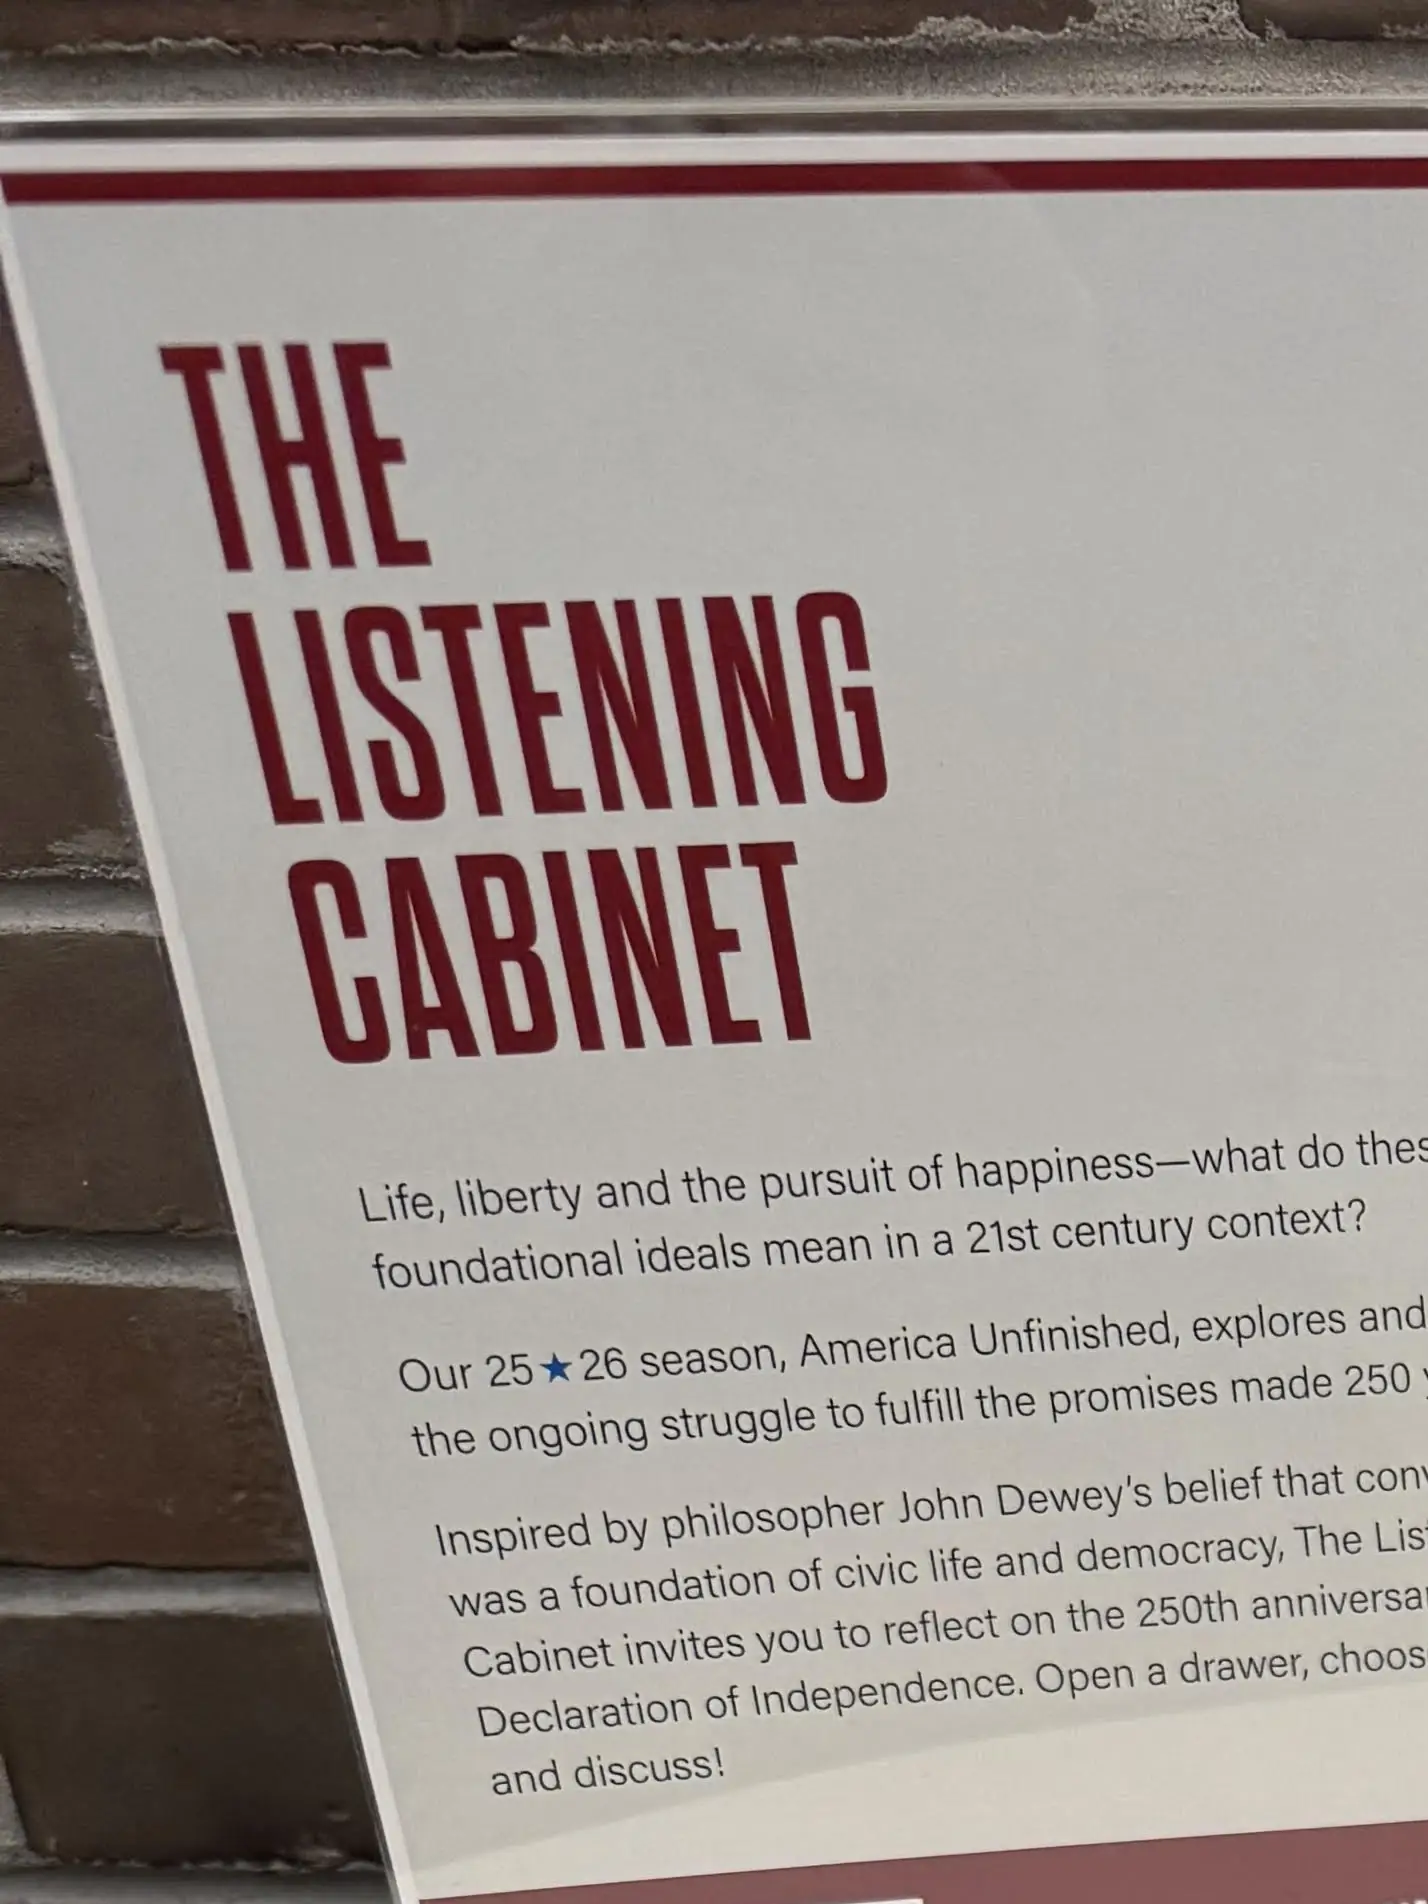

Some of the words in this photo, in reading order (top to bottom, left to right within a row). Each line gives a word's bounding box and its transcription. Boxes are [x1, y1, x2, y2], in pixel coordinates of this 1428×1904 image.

[159, 340, 431, 572] THE
[228, 591, 888, 825] LISTENING
[288, 841, 811, 1064] CABINET
[358, 1182, 445, 1224] Life,
[455, 1177, 581, 1221] liberty
[596, 1168, 671, 1209] and
[680, 1166, 746, 1204] the
[759, 1156, 897, 1209] pursuit
[907, 1152, 944, 1192] of
[1298, 1132, 1345, 1170] do
[371, 1238, 624, 1291] foundational
[634, 1232, 751, 1275] ideals
[763, 1234, 873, 1267] mean
[883, 1223, 920, 1259] in
[933, 1229, 954, 1257] a
[966, 1217, 1041, 1254] 21st
[1052, 1212, 1194, 1252] century
[1207, 1197, 1366, 1241] context?
[398, 1358, 473, 1393] Our
[639, 1344, 786, 1378] season,
[800, 1325, 957, 1368] America
[969, 1309, 1180, 1356] Unfinished,
[1192, 1303, 1347, 1349] explores
[1359, 1293, 1427, 1333] and
[410, 1421, 476, 1458] the
[488, 1410, 649, 1458] ongoing
[660, 1397, 816, 1444] struggle
[825, 1397, 865, 1429] to
[874, 1386, 964, 1426] fulfill
[974, 1384, 1036, 1420] the
[1048, 1374, 1218, 1424] promises
[1230, 1364, 1333, 1404] made
[1344, 1361, 1411, 1397] 250
[434, 1512, 592, 1561] Inspired
[601, 1510, 648, 1552] by
[661, 1494, 885, 1549] philosopher
[899, 1486, 984, 1524] John
[996, 1474, 1153, 1518] Dewey's
[1163, 1465, 1263, 1505] belief
[1271, 1463, 1345, 1498] that
[447, 1588, 527, 1618] was
[539, 1586, 561, 1612] a
[570, 1564, 776, 1609] foundation
[788, 1556, 823, 1593] of
[835, 1551, 919, 1589] civic
[928, 1547, 983, 1583] life
[995, 1540, 1064, 1578] and
[1076, 1535, 1284, 1572] democracy,
[1292, 1523, 1363, 1558] The
[463, 1637, 615, 1678] Cabinet
[622, 1628, 746, 1666] invites
[754, 1627, 824, 1664] you
[833, 1619, 871, 1649] to
[883, 1608, 1001, 1646] reflect
[1010, 1611, 1056, 1637] on
[1065, 1599, 1125, 1633] the
[1136, 1589, 1239, 1628] 250th
[476, 1692, 693, 1737] Declaration
[705, 1684, 740, 1719] of
[751, 1670, 1024, 1717] Independence.
[1035, 1662, 1135, 1700] Open
[1147, 1662, 1167, 1686] a
[1179, 1650, 1309, 1684] drawer,
[491, 1758, 562, 1796] and
[574, 1746, 725, 1789] discuss!
